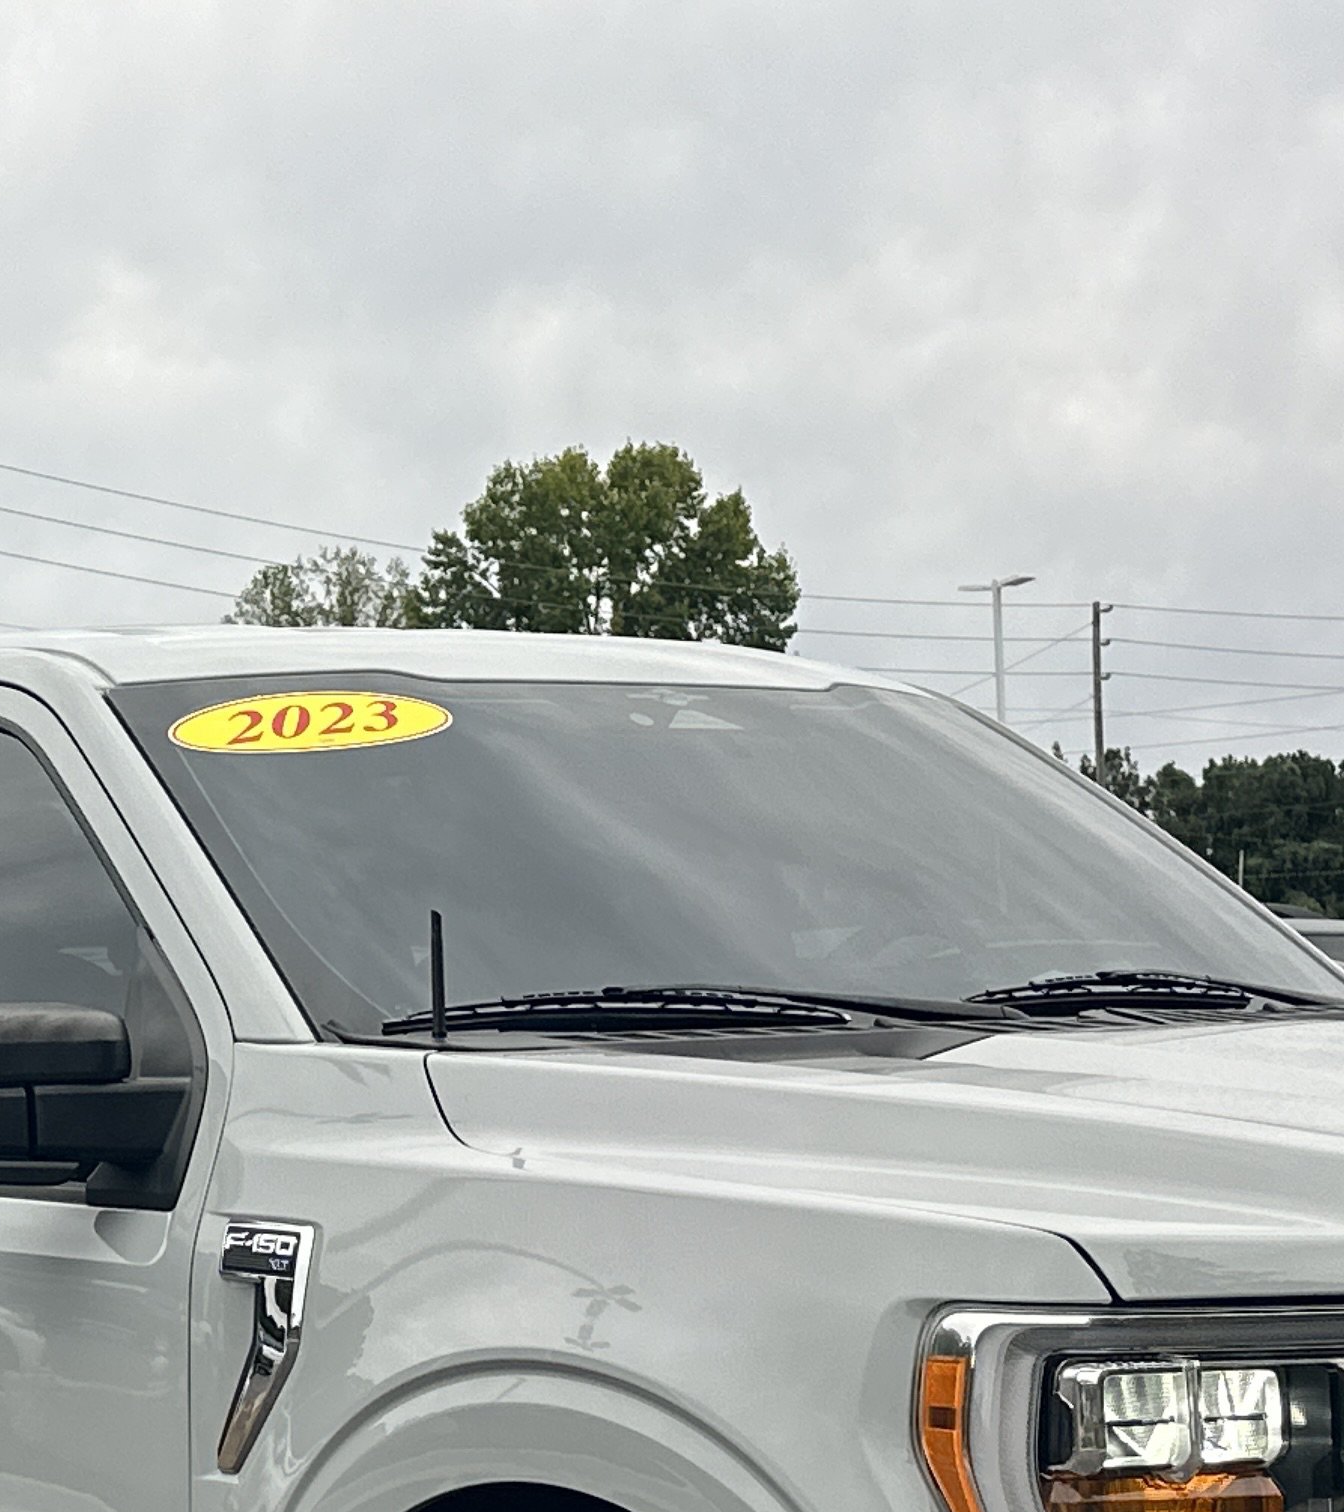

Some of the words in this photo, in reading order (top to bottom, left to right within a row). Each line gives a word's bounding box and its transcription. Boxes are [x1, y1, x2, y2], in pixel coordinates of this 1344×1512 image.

[226, 701, 399, 746] 2023
[224, 1231, 298, 1256] F-150
[268, 1257, 289, 1271] XLT
